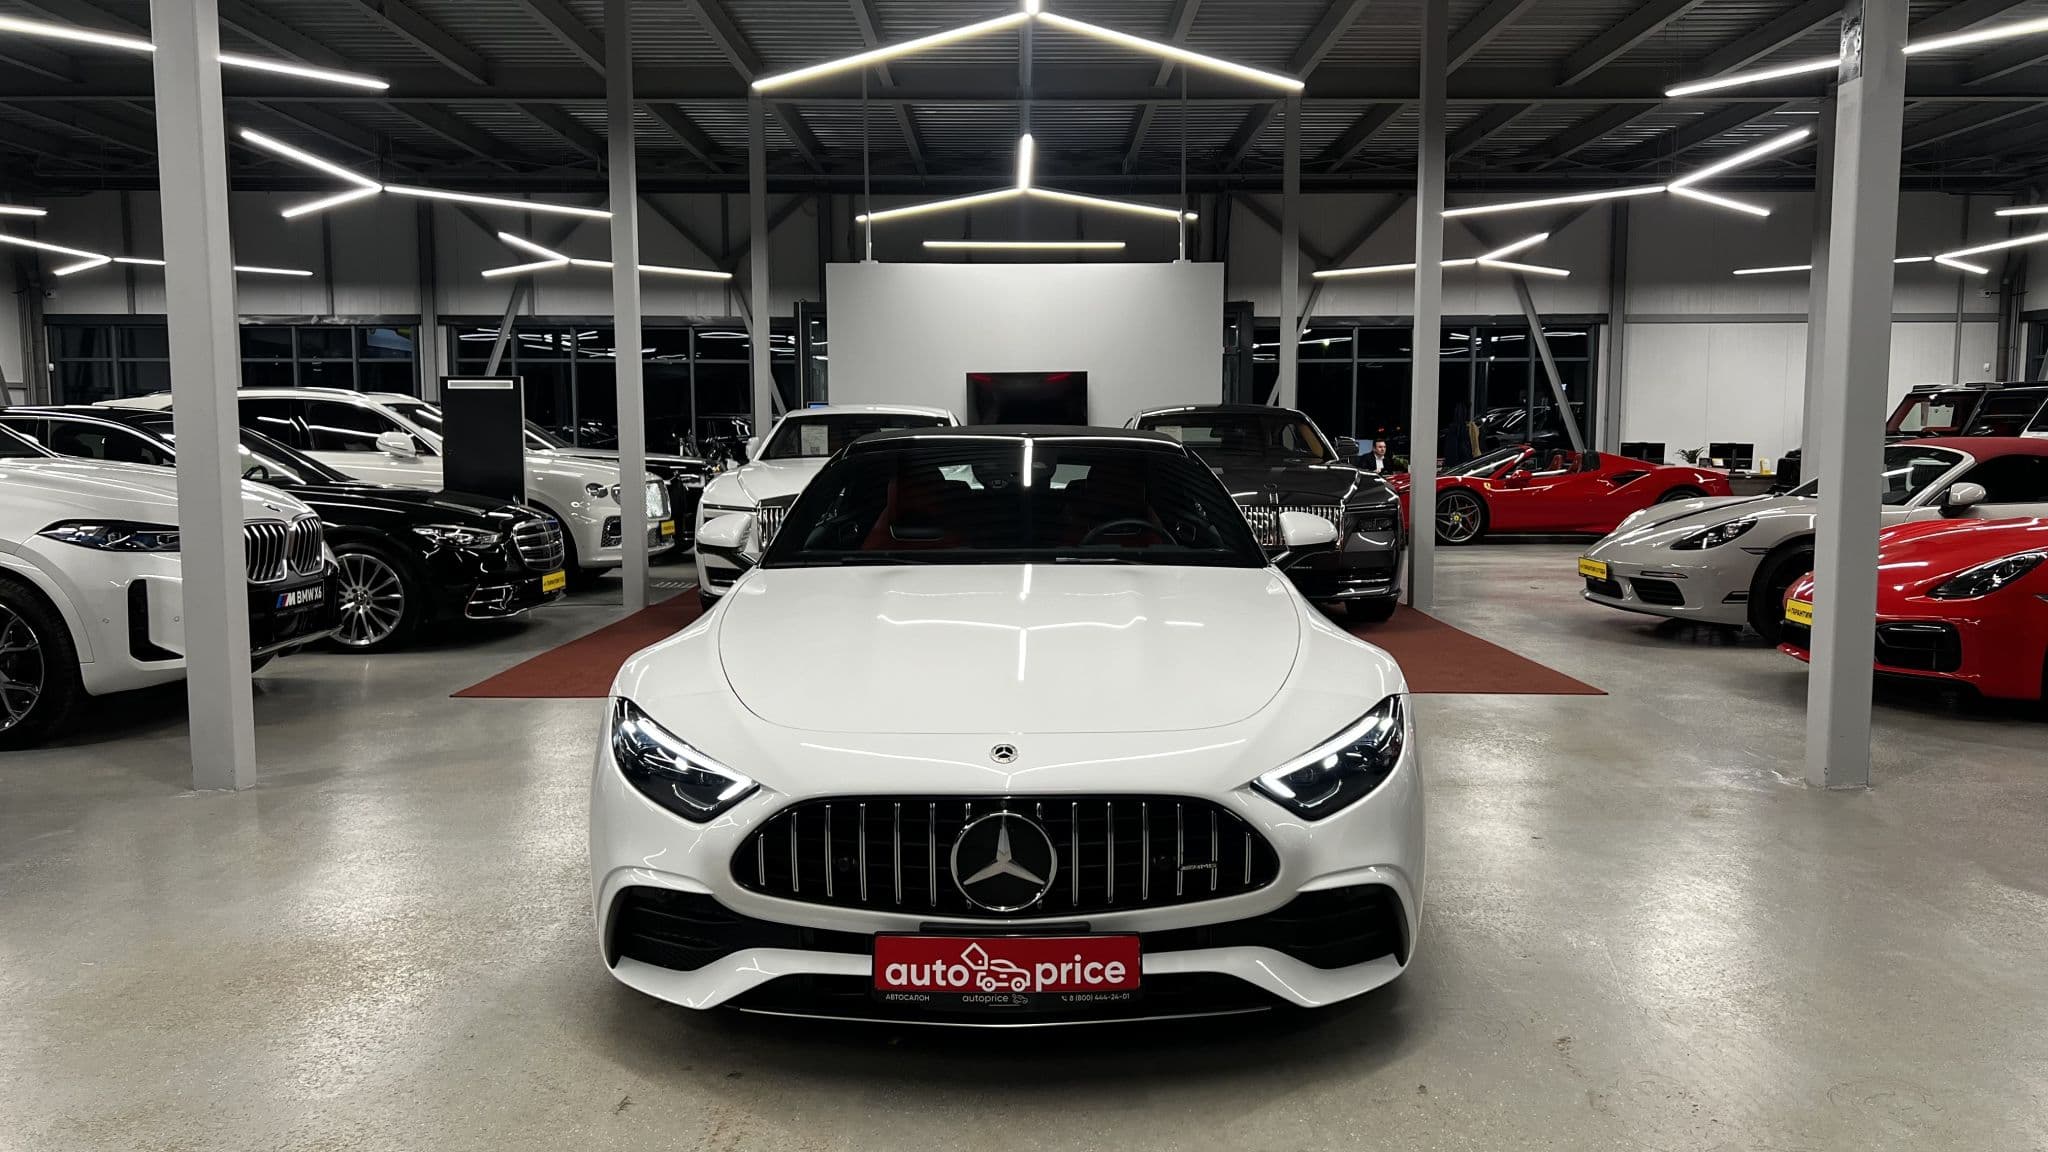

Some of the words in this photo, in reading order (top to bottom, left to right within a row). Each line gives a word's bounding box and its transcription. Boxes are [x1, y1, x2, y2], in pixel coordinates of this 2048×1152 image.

[296, 587, 314, 604] BMW
[314, 586, 323, 600] X6
[885, 959, 970, 987] auto
[1035, 953, 1126, 993] price
[885, 993, 930, 1002] АВТОСАЛОН
[962, 994, 1009, 1004] autoprice
[1069, 994, 1074, 1002] 8
[1075, 993, 1093, 1002] (800)
[1094, 992, 1130, 1001] 444-24-01
